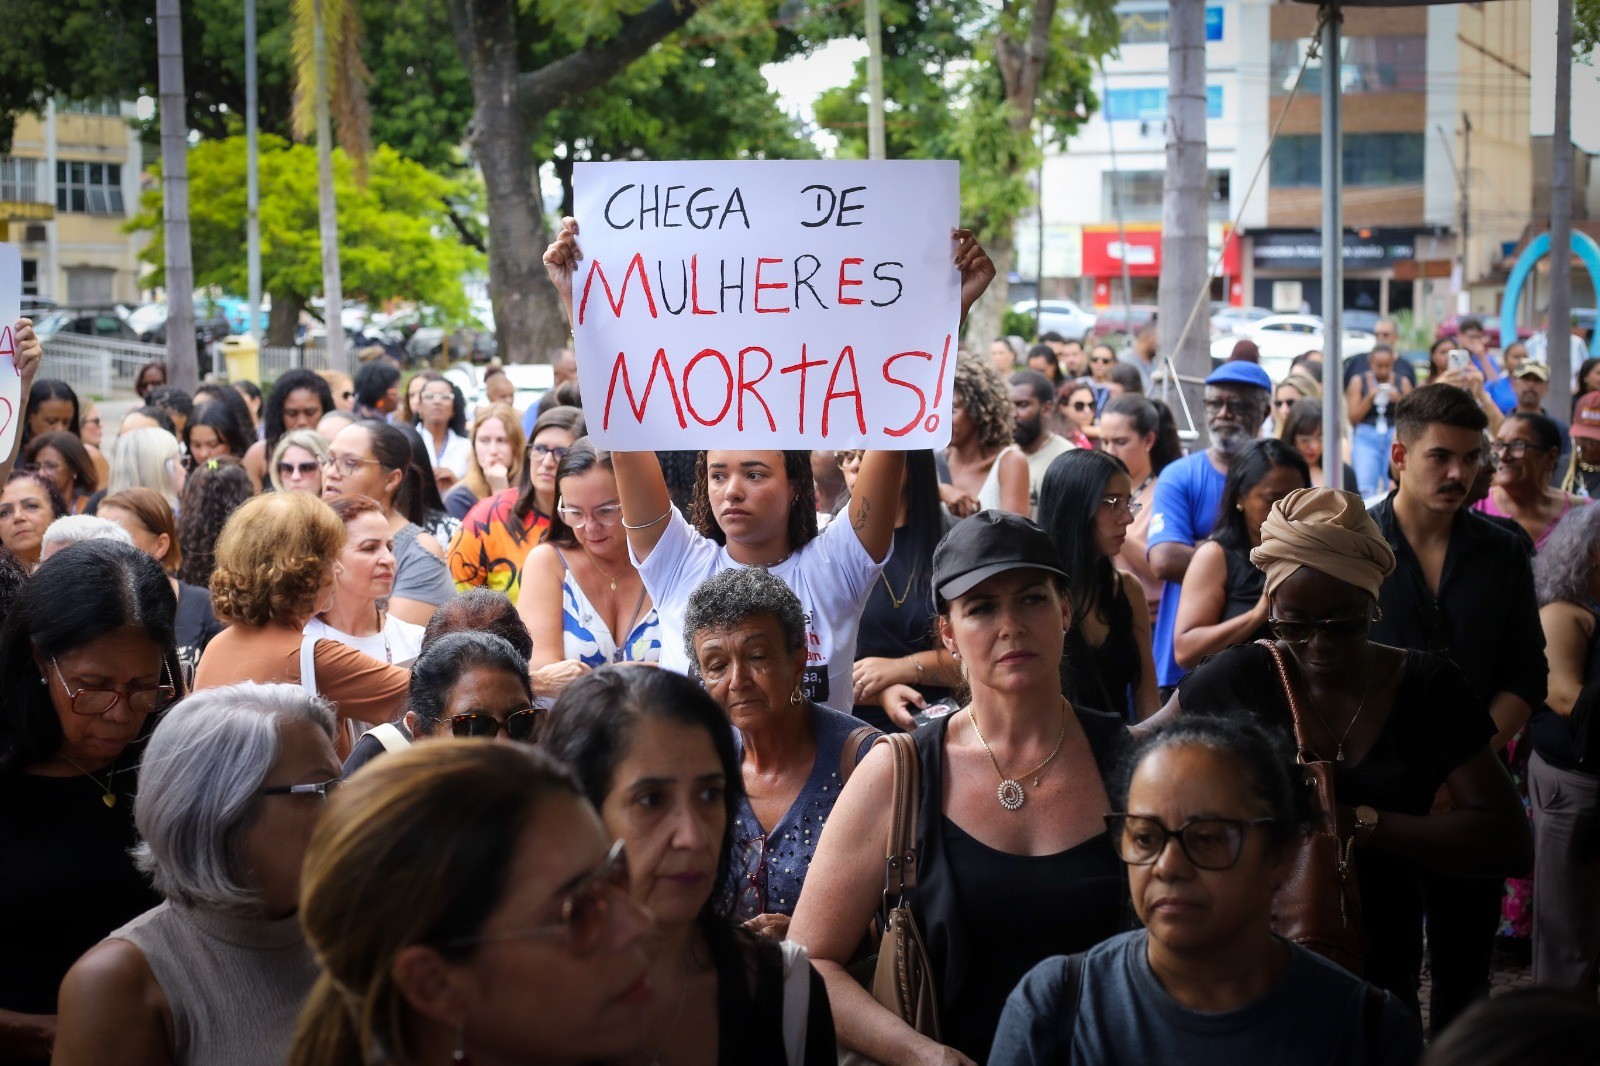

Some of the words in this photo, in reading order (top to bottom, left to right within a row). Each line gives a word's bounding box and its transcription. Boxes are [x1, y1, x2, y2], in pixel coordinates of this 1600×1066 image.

[604, 183, 750, 230] CHEGA
[800, 184, 867, 229] DE
[578, 252, 904, 326] MULHERES
[603, 334, 952, 438] MORTAS!
